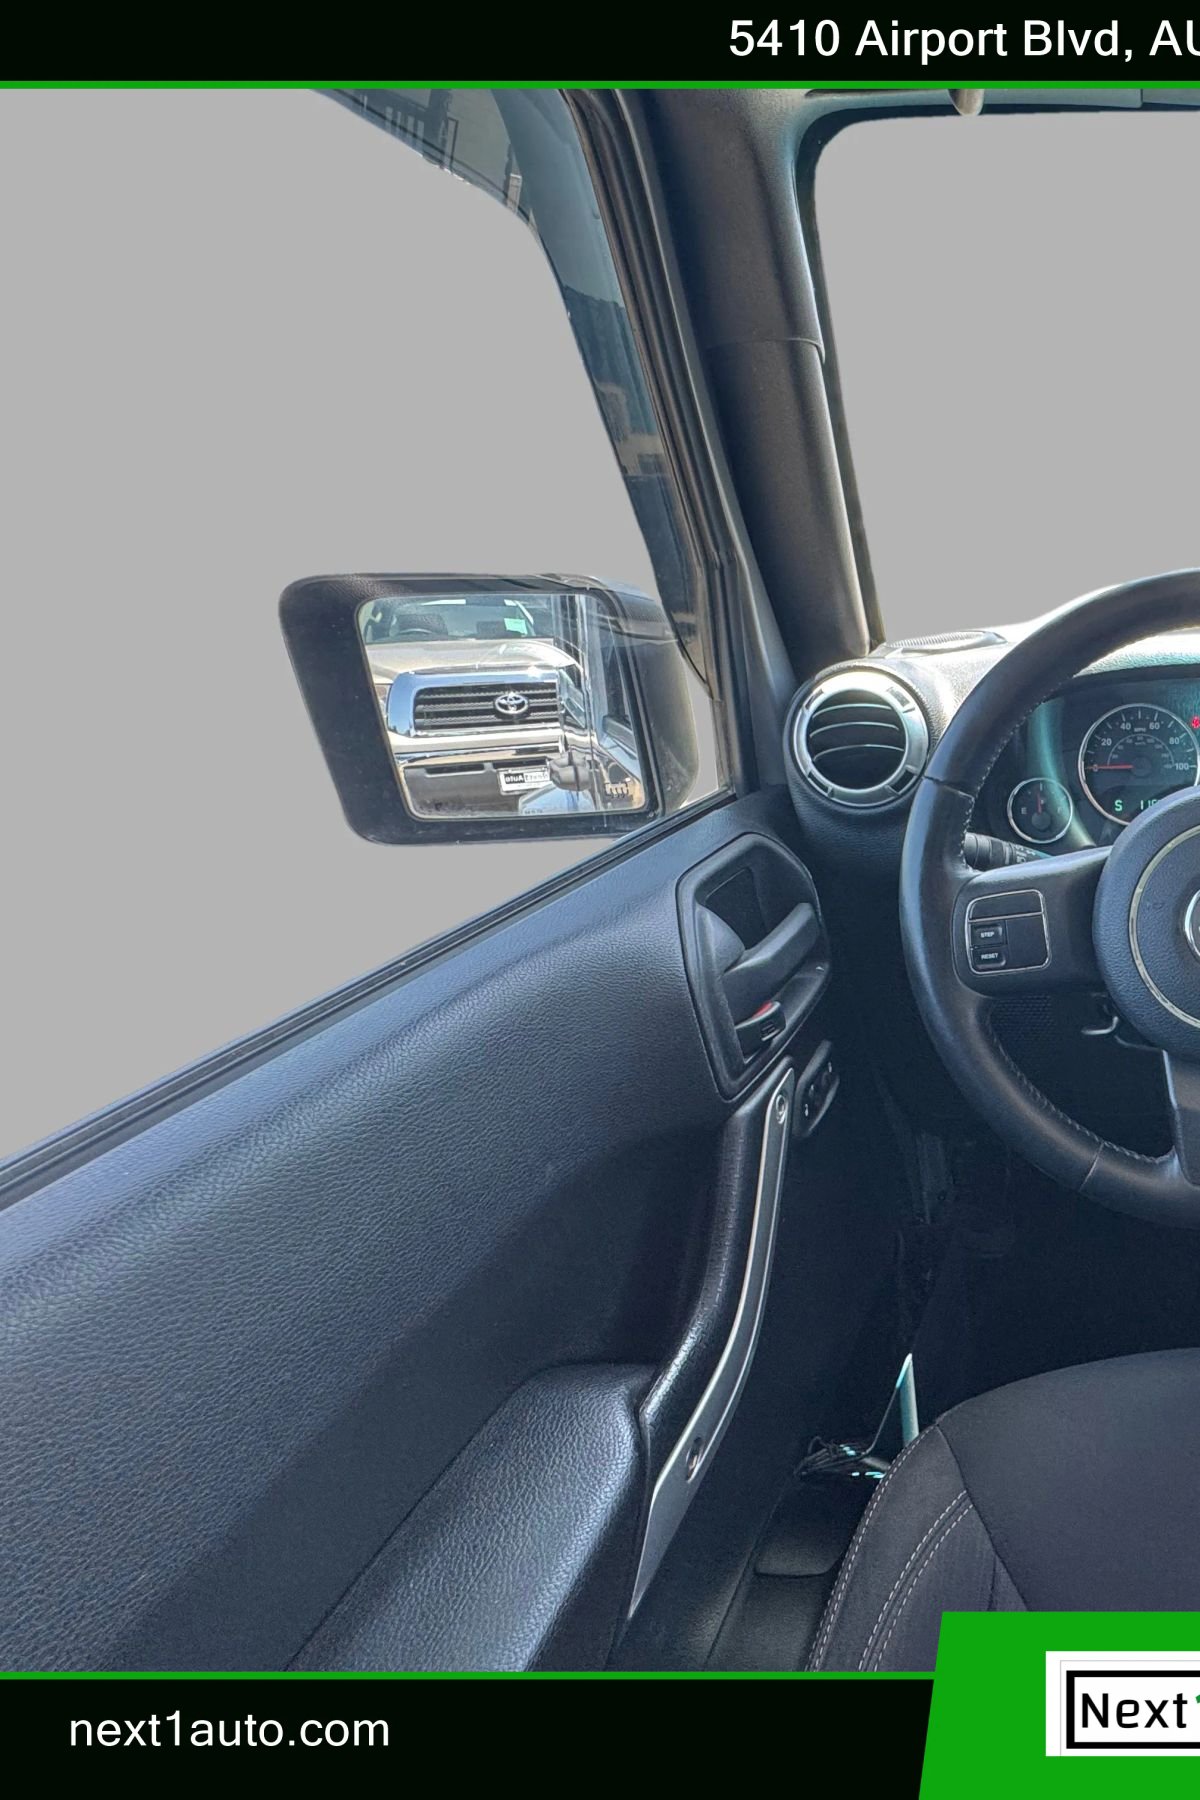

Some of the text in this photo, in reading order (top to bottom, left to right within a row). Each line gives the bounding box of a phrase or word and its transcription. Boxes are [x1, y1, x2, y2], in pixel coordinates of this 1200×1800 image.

[1120, 722, 1131, 730] 40
[1149, 722, 1160, 730] 60
[1101, 738, 1112, 746] 20
[1169, 737, 1180, 745] 80
[1174, 762, 1190, 771] 100
[1114, 799, 1123, 812] S
